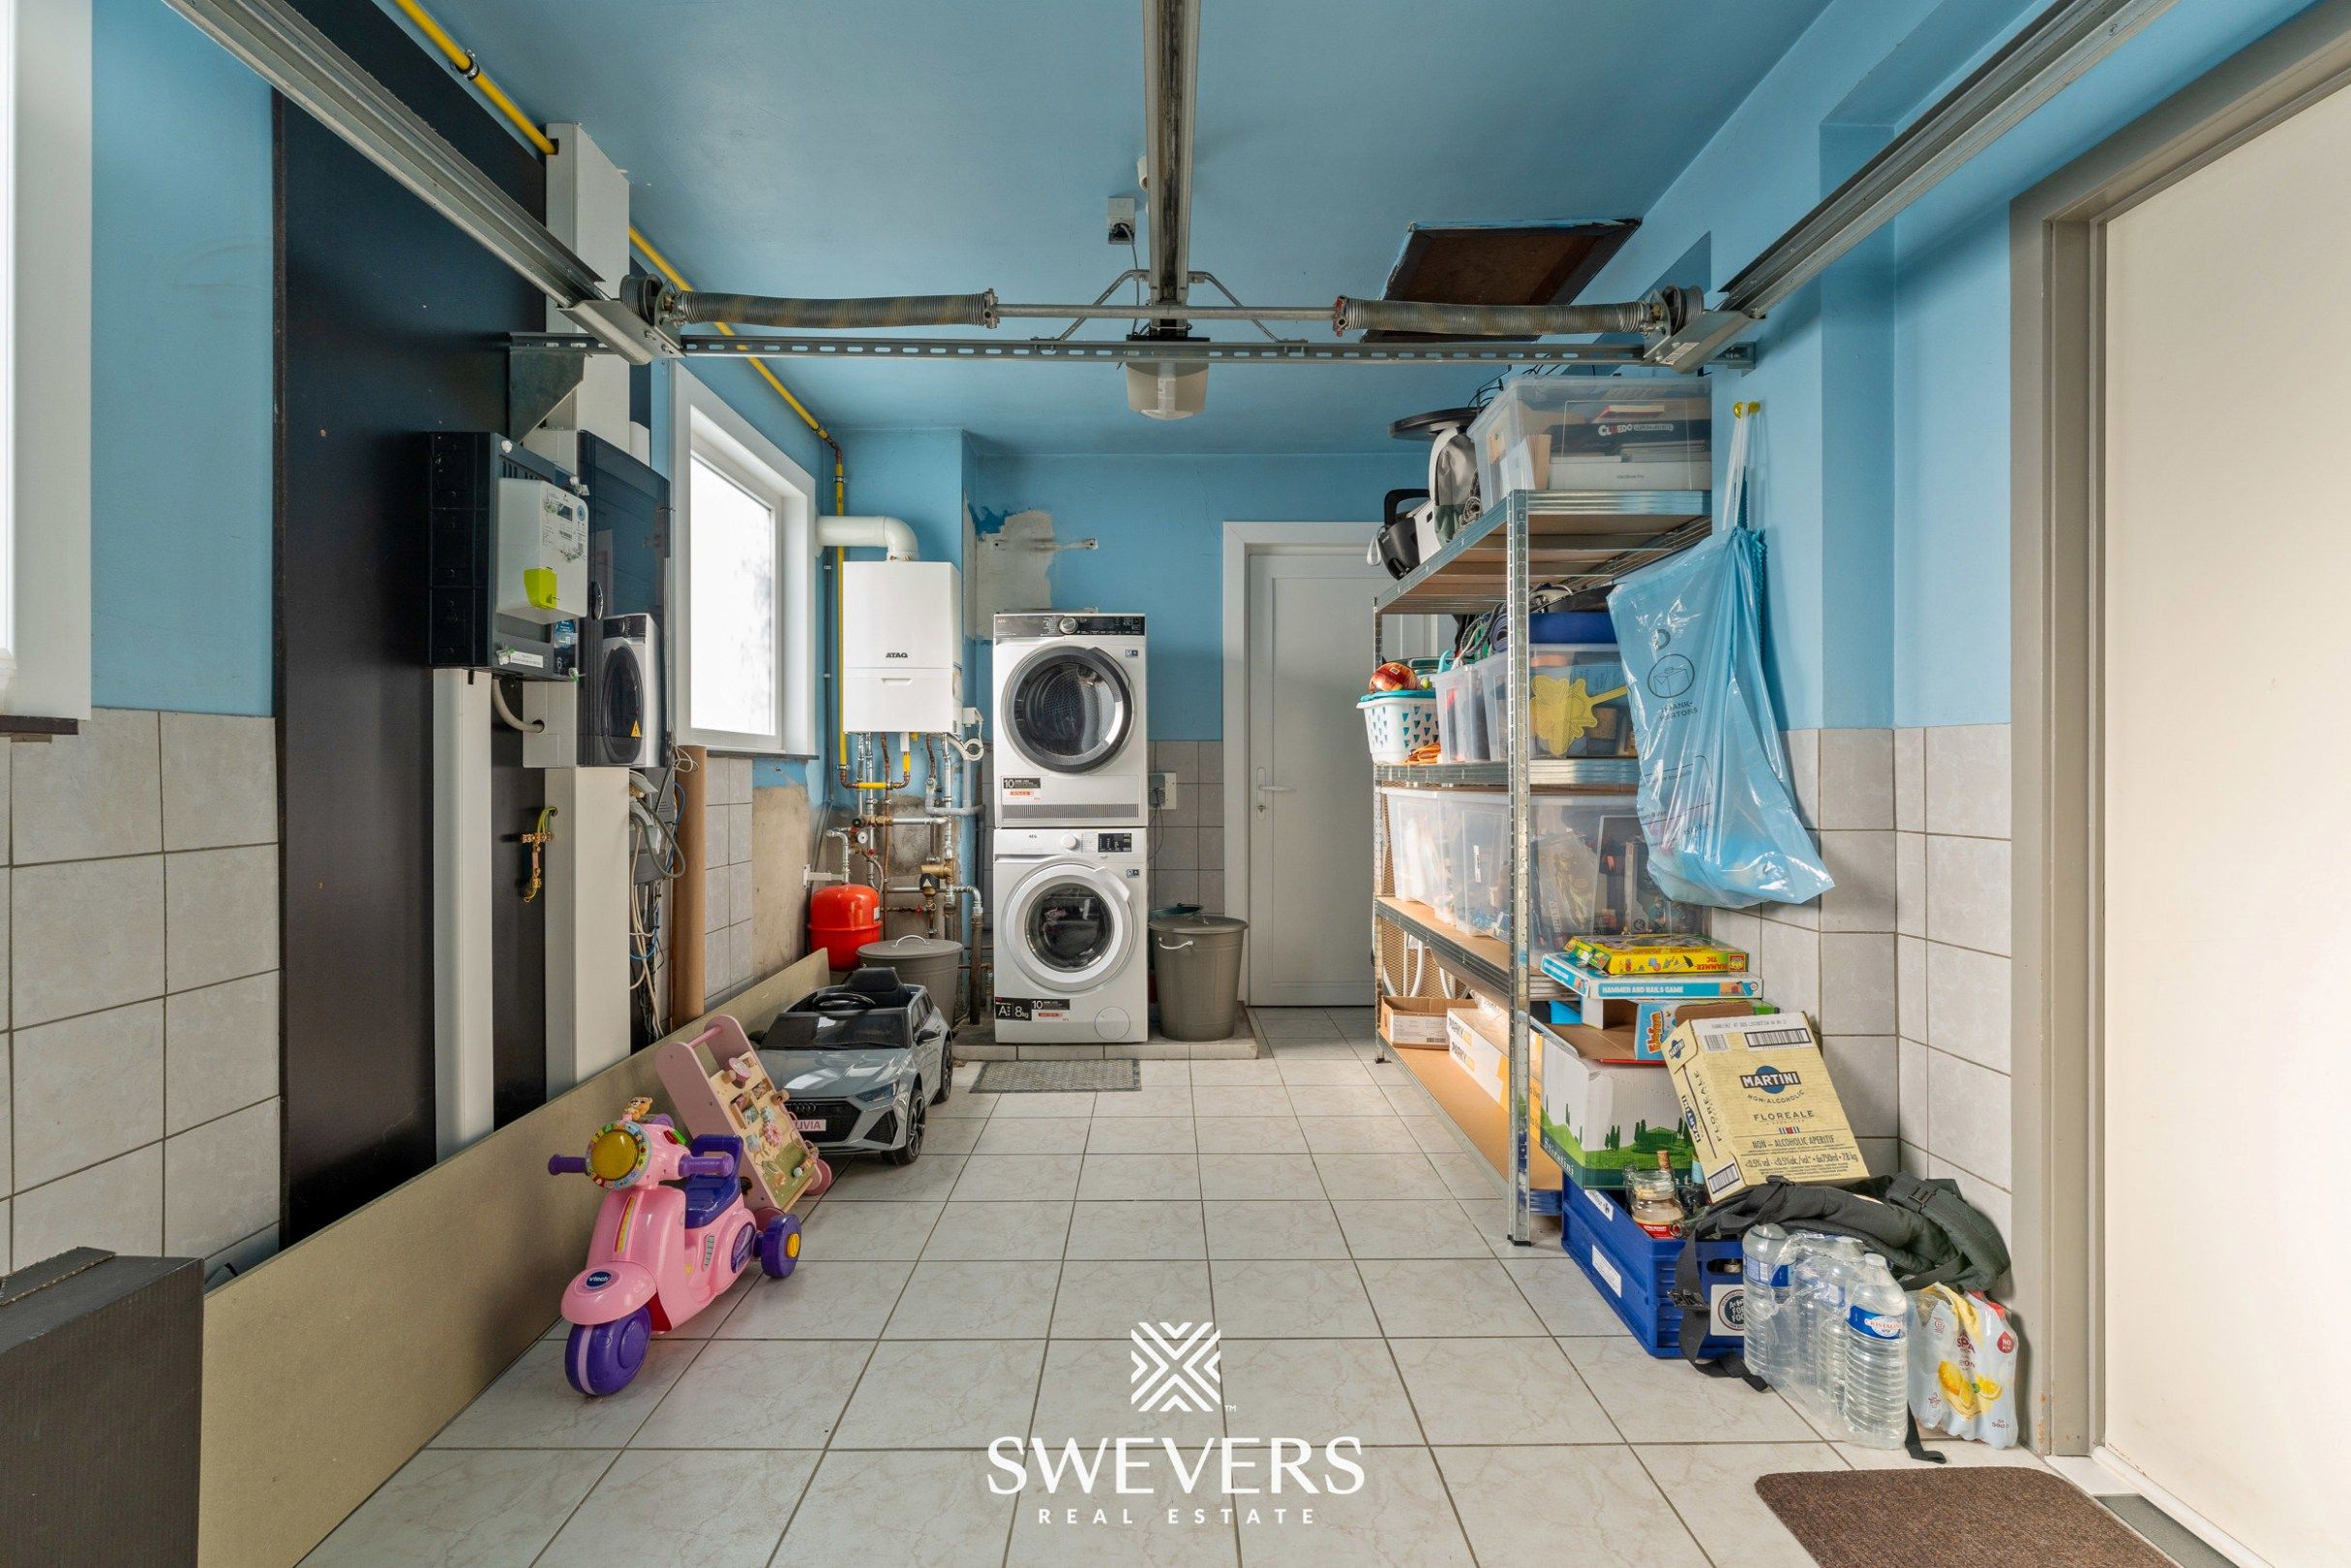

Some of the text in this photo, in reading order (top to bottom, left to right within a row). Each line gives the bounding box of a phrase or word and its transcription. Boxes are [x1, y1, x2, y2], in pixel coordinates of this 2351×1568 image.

[1004, 779, 1015, 788] 10
[1032, 1000, 1043, 1010] 10
[1742, 1072, 1799, 1088] MARTINI
[1747, 1089, 1805, 1104] NON-ALCOHOLIC
[1694, 1070, 1723, 1143] FLOREALE
[1753, 1109, 1815, 1122] FLOREALE
[1752, 1140, 1767, 1149] NON
[1775, 1137, 1808, 1148] ALCOHOLIC
[1809, 1134, 1835, 1145] APERITIF
